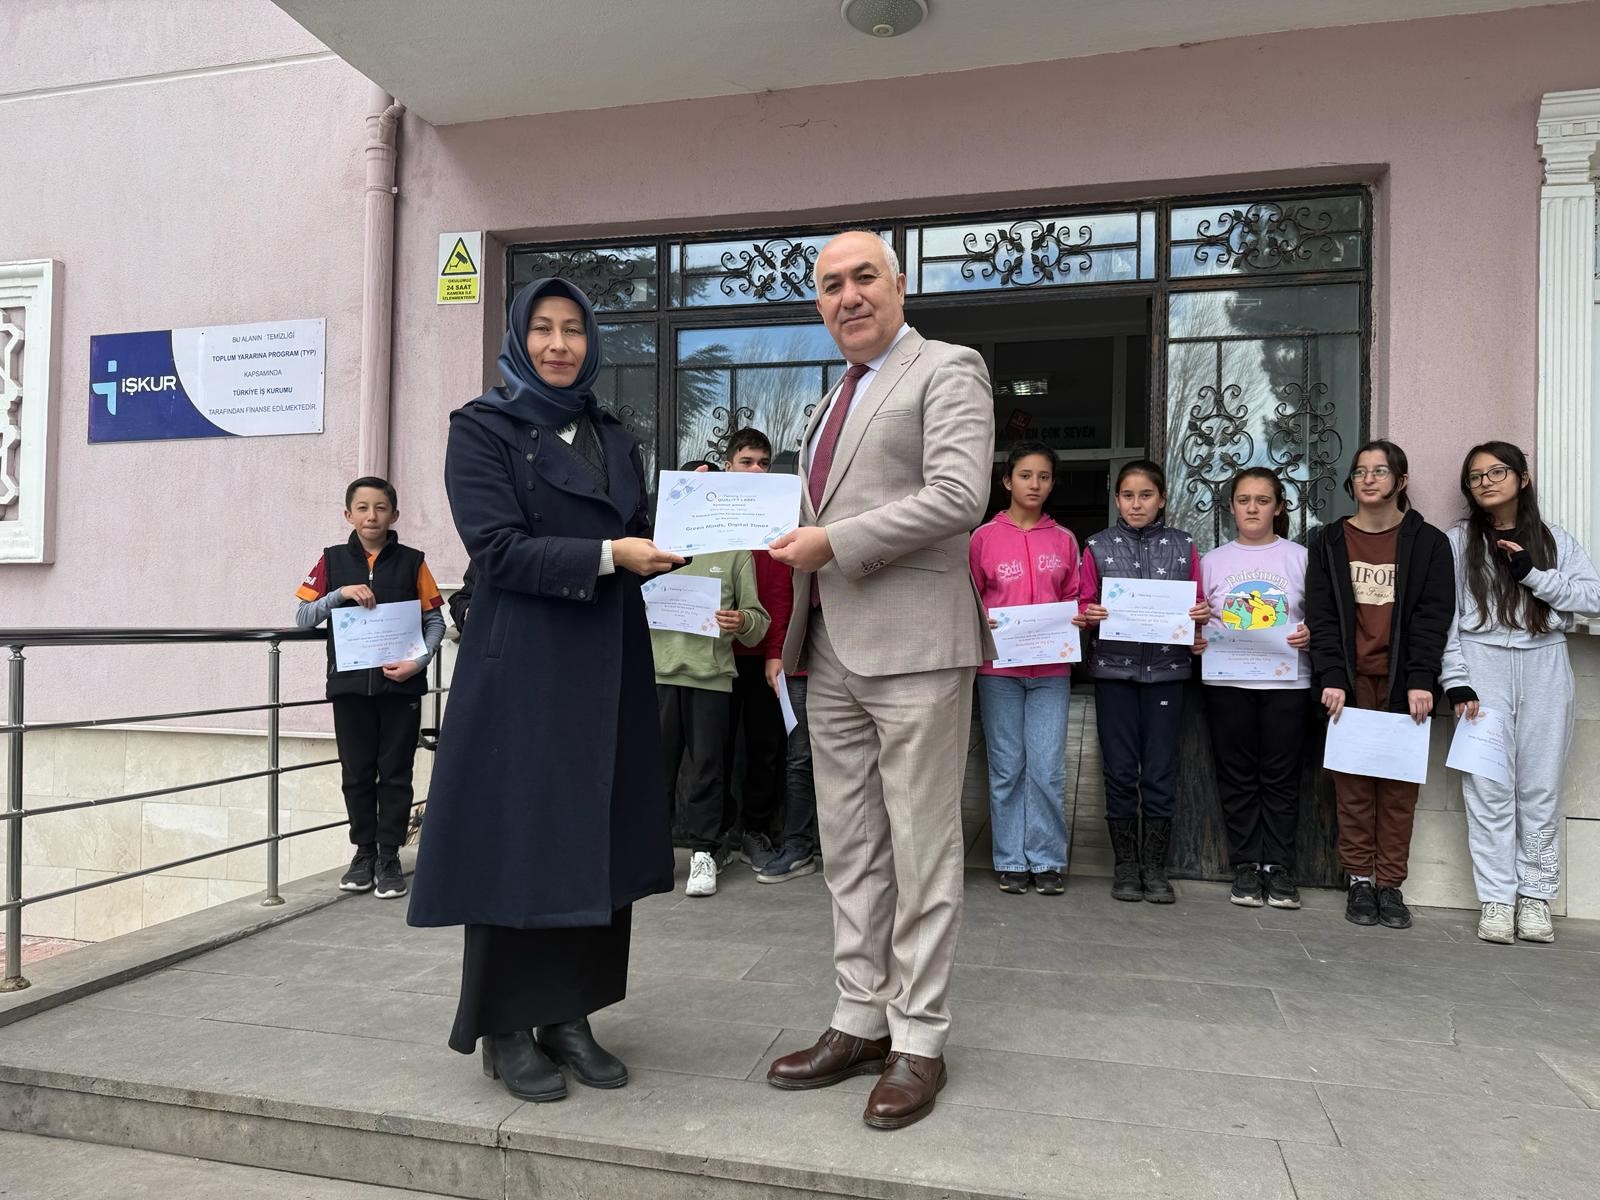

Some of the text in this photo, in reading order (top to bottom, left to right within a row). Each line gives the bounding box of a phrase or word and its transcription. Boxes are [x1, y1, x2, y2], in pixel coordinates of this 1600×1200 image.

[242, 334, 263, 342] ALANIN
[266, 331, 295, 340] TEMİZLİĞİ
[212, 349, 317, 363] TOPLUM YARARINA PROGRAM (TYP)
[243, 369, 283, 378] KAPSAMINDA
[233, 387, 293, 397] TÜRKİYE İŞ KURUMU
[208, 402, 318, 416] TARAFINDAN FİNANSE EDİLMEKTEDİR.
[998, 560, 1023, 579] Sixty
[1226, 568, 1289, 590] Pokémon
[1524, 864, 1538, 889] ORK
